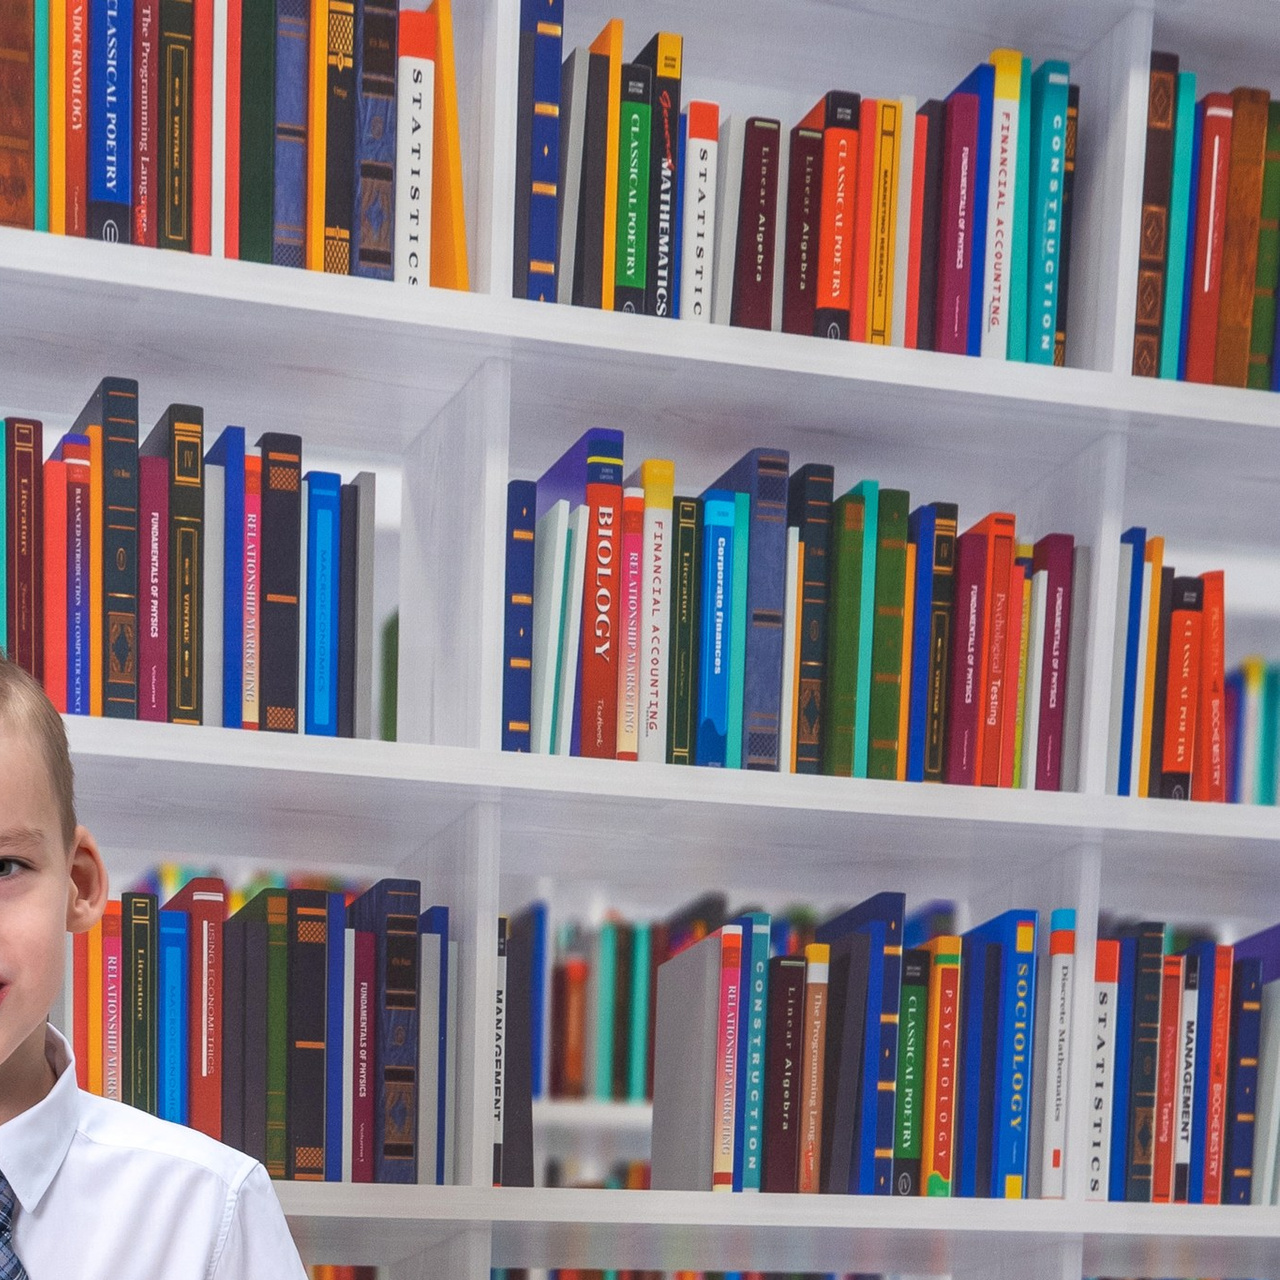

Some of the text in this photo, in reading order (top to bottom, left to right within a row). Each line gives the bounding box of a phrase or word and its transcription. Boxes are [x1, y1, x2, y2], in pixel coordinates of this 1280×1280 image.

[71, 0, 83, 131] NDOCRINOLOGY
[140, 5, 152, 36] The
[105, 108, 118, 192] POETRY
[138, 40, 152, 151] Programming
[172, 115, 181, 169] VINTAGE
[407, 67, 424, 286] STATISTICS
[625, 113, 641, 279] CLASSICAL POETRY
[655, 157, 674, 317] MATHEMATICS
[754, 146, 771, 284] Linear Algebra
[798, 155, 815, 292] Linear Algebra
[830, 138, 848, 299] CLASSICAL POETRY
[877, 168, 890, 298] MARKETING RESEARCH
[955, 146, 970, 269] FUNDAMENTALS OF PHYSICS
[990, 111, 1011, 327] FINANCIAL ACCOUNTING
[1040, 114, 1063, 351] CONSTRUCTION
[20, 477, 29, 556] Literature
[74, 487, 83, 536] BALANCED
[74, 537, 83, 606] INTRODUCTION
[650, 520, 664, 617] FINANCIAL
[715, 537, 726, 608] Corporate
[74, 612, 82, 624] TO
[149, 511, 160, 638] FUNDAMENTALS OF PHYSICS
[183, 593, 191, 644] VINTAGE
[245, 513, 258, 703] RELATIONSHIP MARKETING
[317, 548, 329, 693] MACROECONOMICS
[593, 505, 615, 663] BIOLOGY
[680, 552, 691, 623] Literature
[966, 584, 978, 652] FUNDAMENTALS
[1052, 587, 1064, 656] FUNDAMENTALS
[74, 625, 82, 675] COMPUTER
[623, 552, 639, 735] RELATIONSHIP MARKETING
[647, 624, 661, 731] ACCOUNTING
[964, 667, 975, 704] PHYSICS
[986, 593, 1006, 726] Psychological Testing
[1048, 671, 1060, 709] PHYSICS
[596, 698, 605, 748] Textbook
[1209, 698, 1221, 787] BIOCHEMISTRY
[107, 955, 118, 1053] RELATIONSHIP
[136, 948, 145, 1021] Literature
[205, 922, 217, 1075] USING ECONOMETRICS
[357, 981, 368, 1098] FUNDAMENTALS OF PHYSICS
[1053, 964, 1070, 1123] Discrete Mathematics
[493, 989, 504, 1122] MANAGEMENT
[721, 984, 737, 1156] RELATIONSHIP MARKETING
[748, 961, 765, 1170] CONSTRUCTION
[781, 986, 797, 1132] Linear Algebra
[808, 991, 823, 1109] The Programming
[902, 995, 918, 1150] CLASSICAL POETRY
[937, 988, 954, 1159] PSYCHOLOGY
[1010, 964, 1029, 1131] SOCIOLOGY
[1089, 990, 1109, 1192] STATISTICS
[1180, 1020, 1196, 1144] MANAGEMENT
[1159, 1101, 1172, 1144] Testing
[1209, 1083, 1222, 1177] BIOCHEMISTRY
